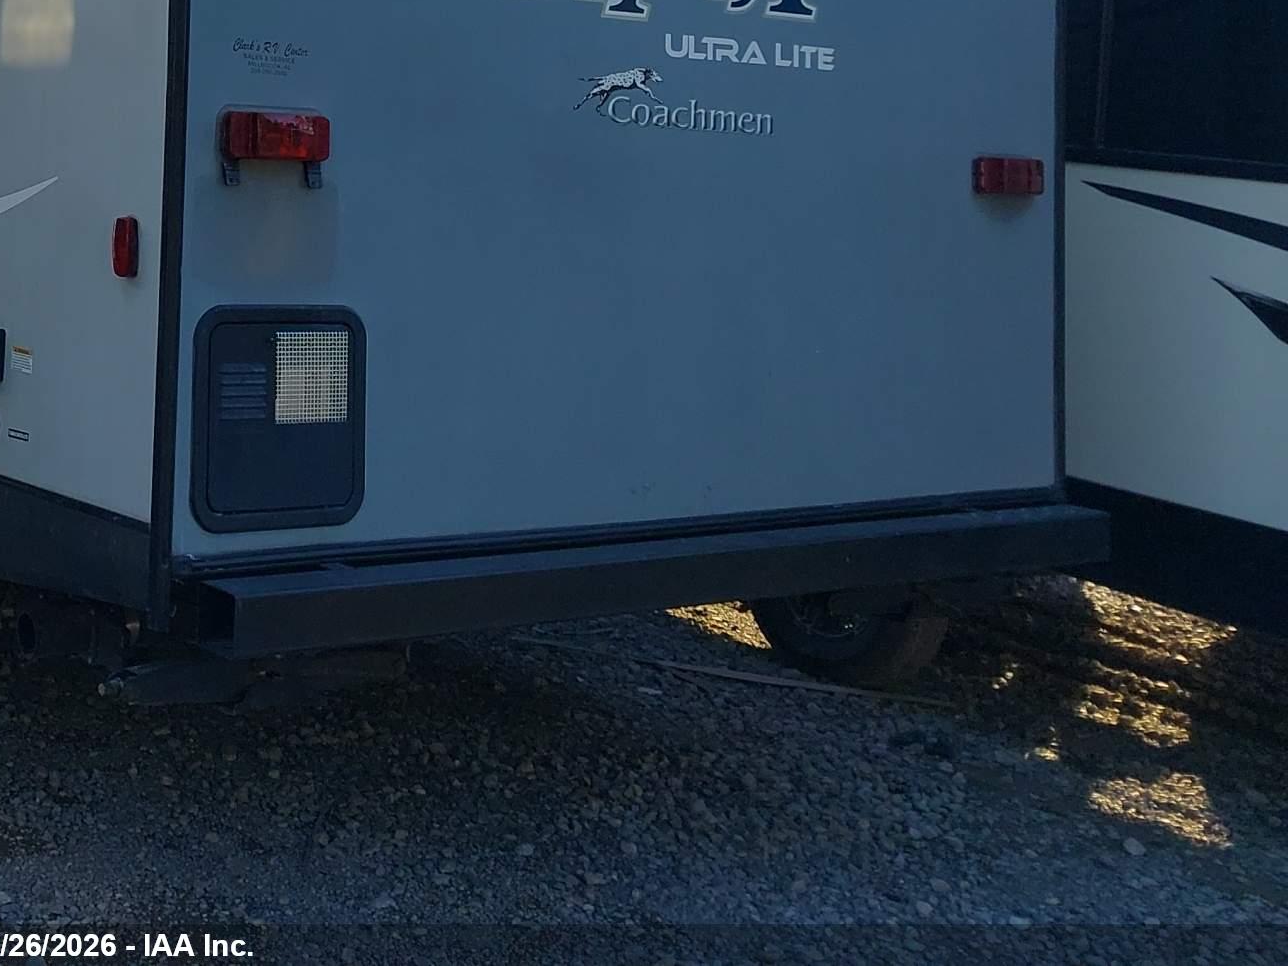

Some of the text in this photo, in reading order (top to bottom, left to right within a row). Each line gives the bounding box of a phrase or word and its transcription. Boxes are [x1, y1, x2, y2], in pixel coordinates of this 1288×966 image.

[665, 34, 836, 71] ULTRA LITE
[607, 95, 774, 135] Coachmen
